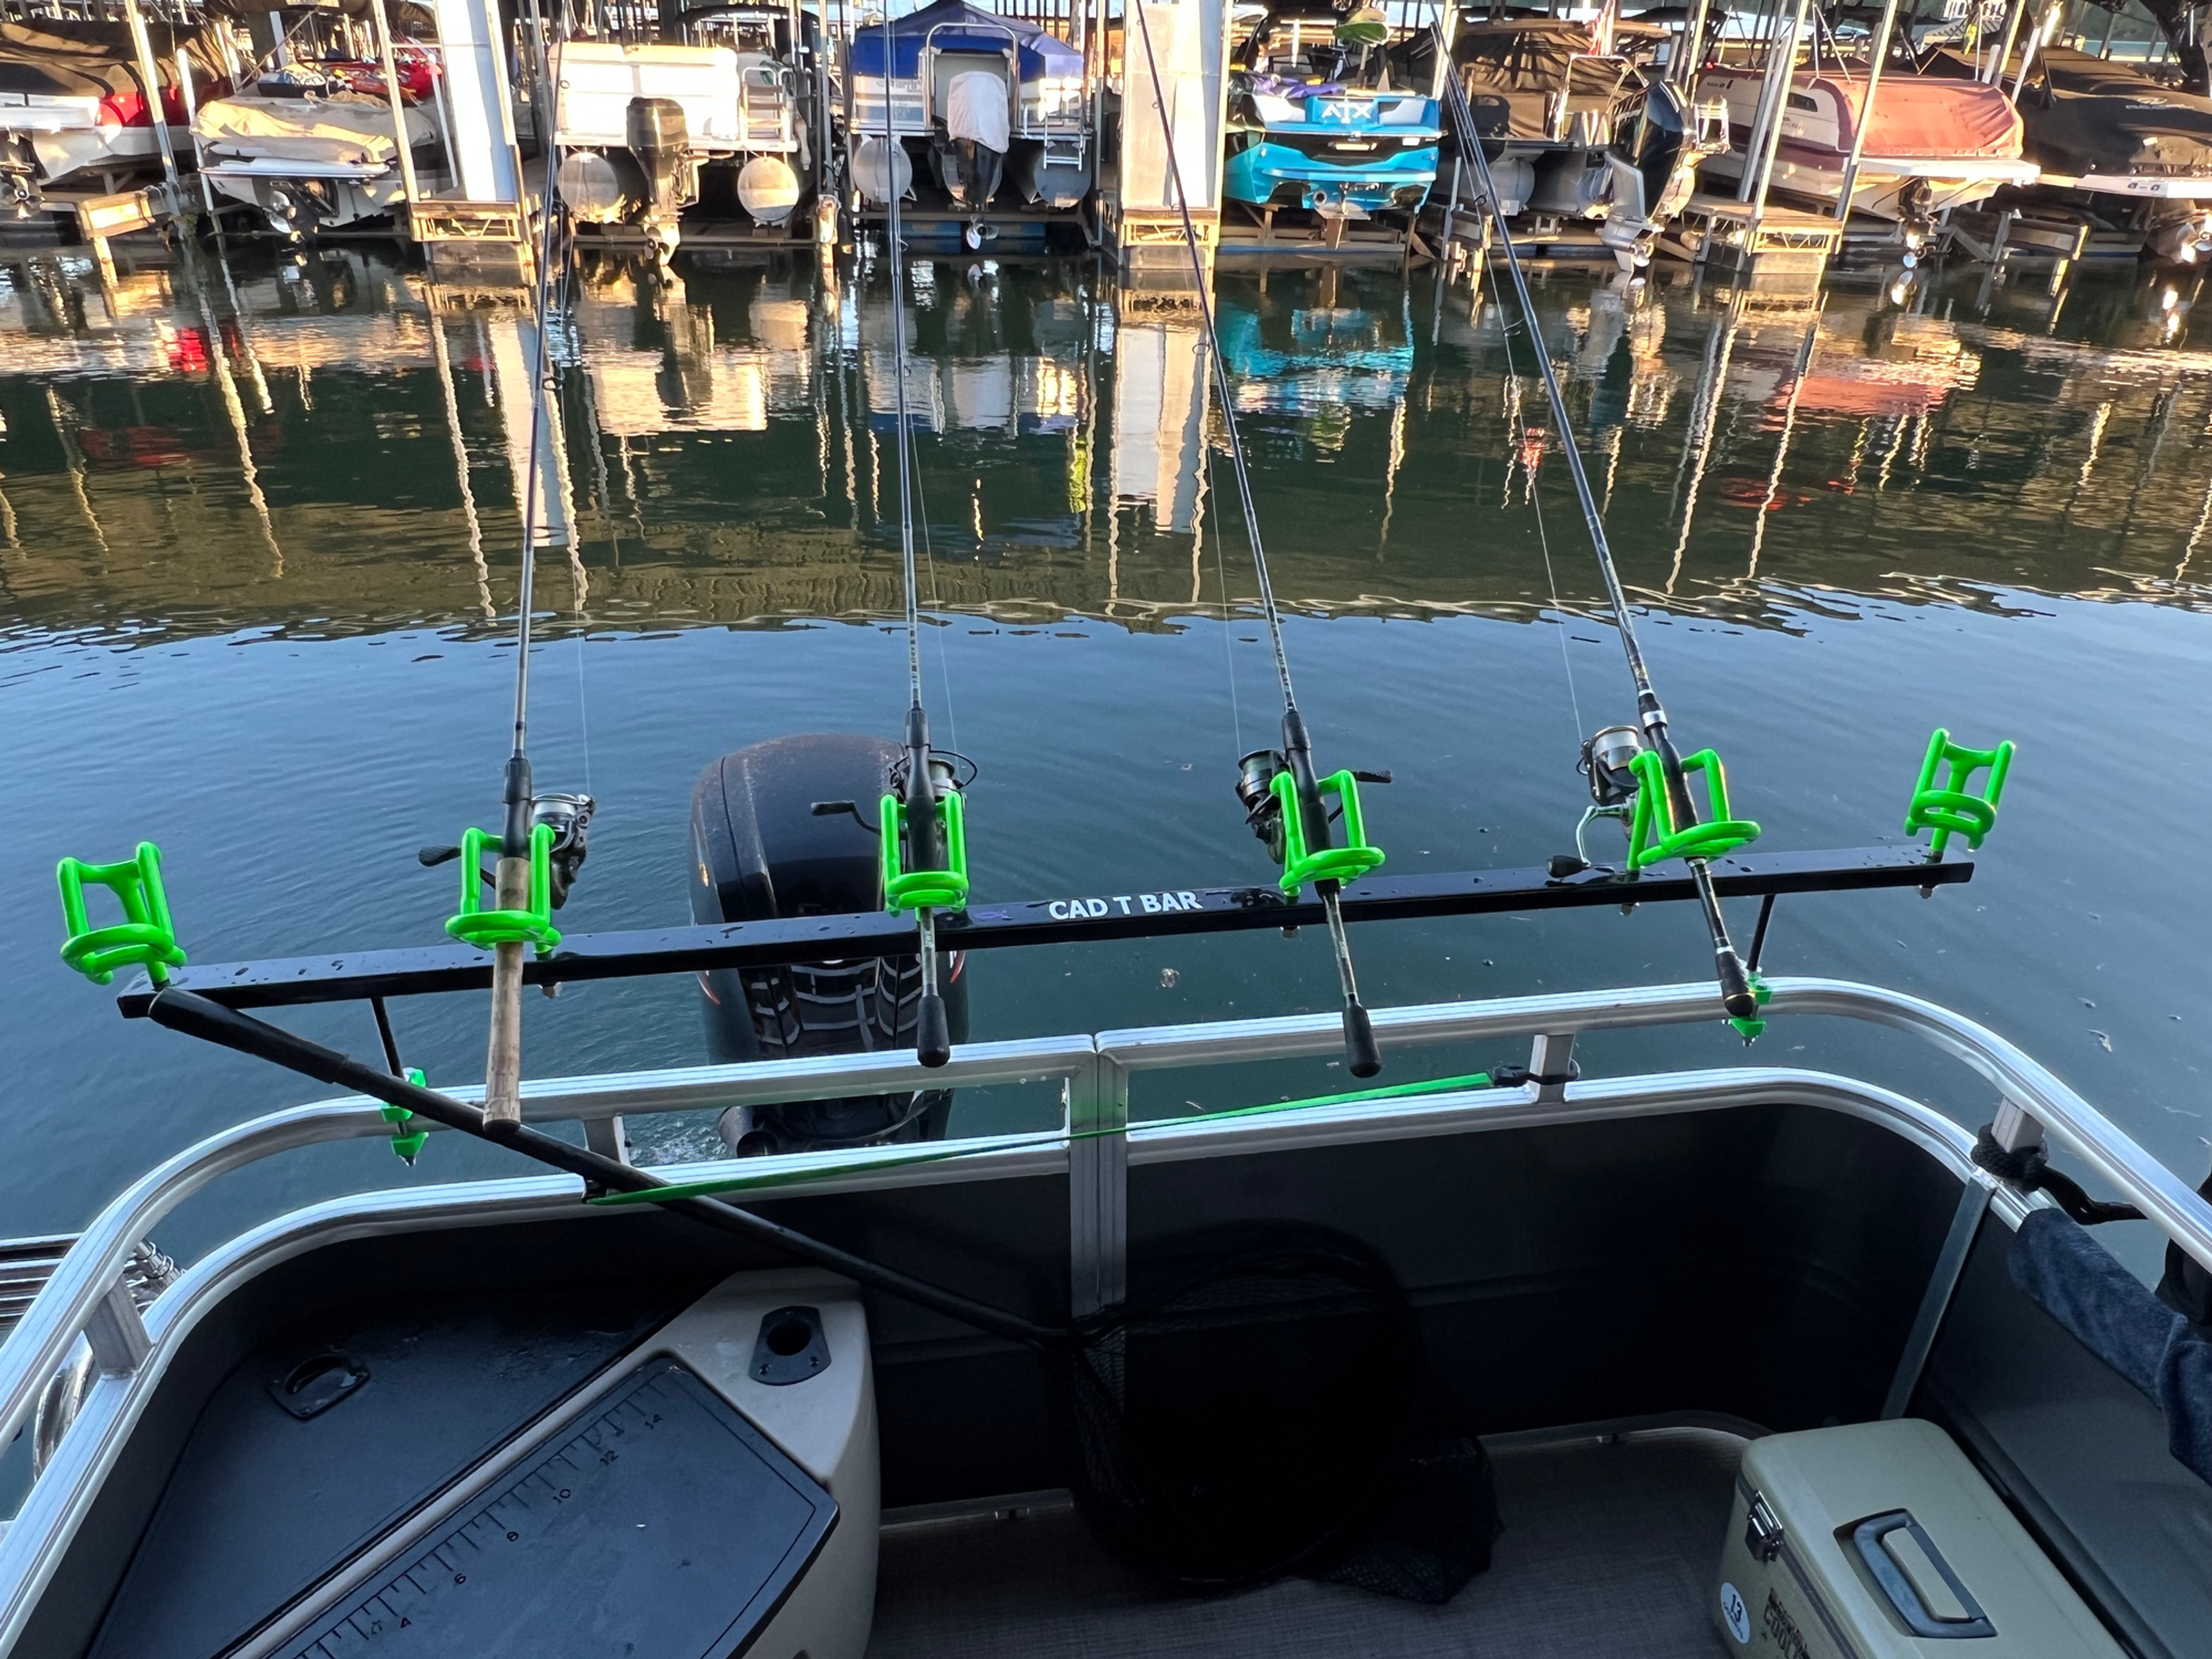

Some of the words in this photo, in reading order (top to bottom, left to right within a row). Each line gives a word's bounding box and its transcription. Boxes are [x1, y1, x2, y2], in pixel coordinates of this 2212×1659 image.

[1321, 102, 1372, 119] ATX
[1049, 899, 1108, 919] CAD
[1113, 896, 1132, 915] T
[1139, 891, 1203, 912] BAR
[645, 1413, 662, 1430] 14
[600, 1450, 619, 1466] 12
[552, 1488, 571, 1506] 10
[506, 1531, 519, 1542] 8
[454, 1573, 466, 1584] 6
[1730, 1594, 1742, 1622] 13
[400, 1617, 412, 1629] 4
